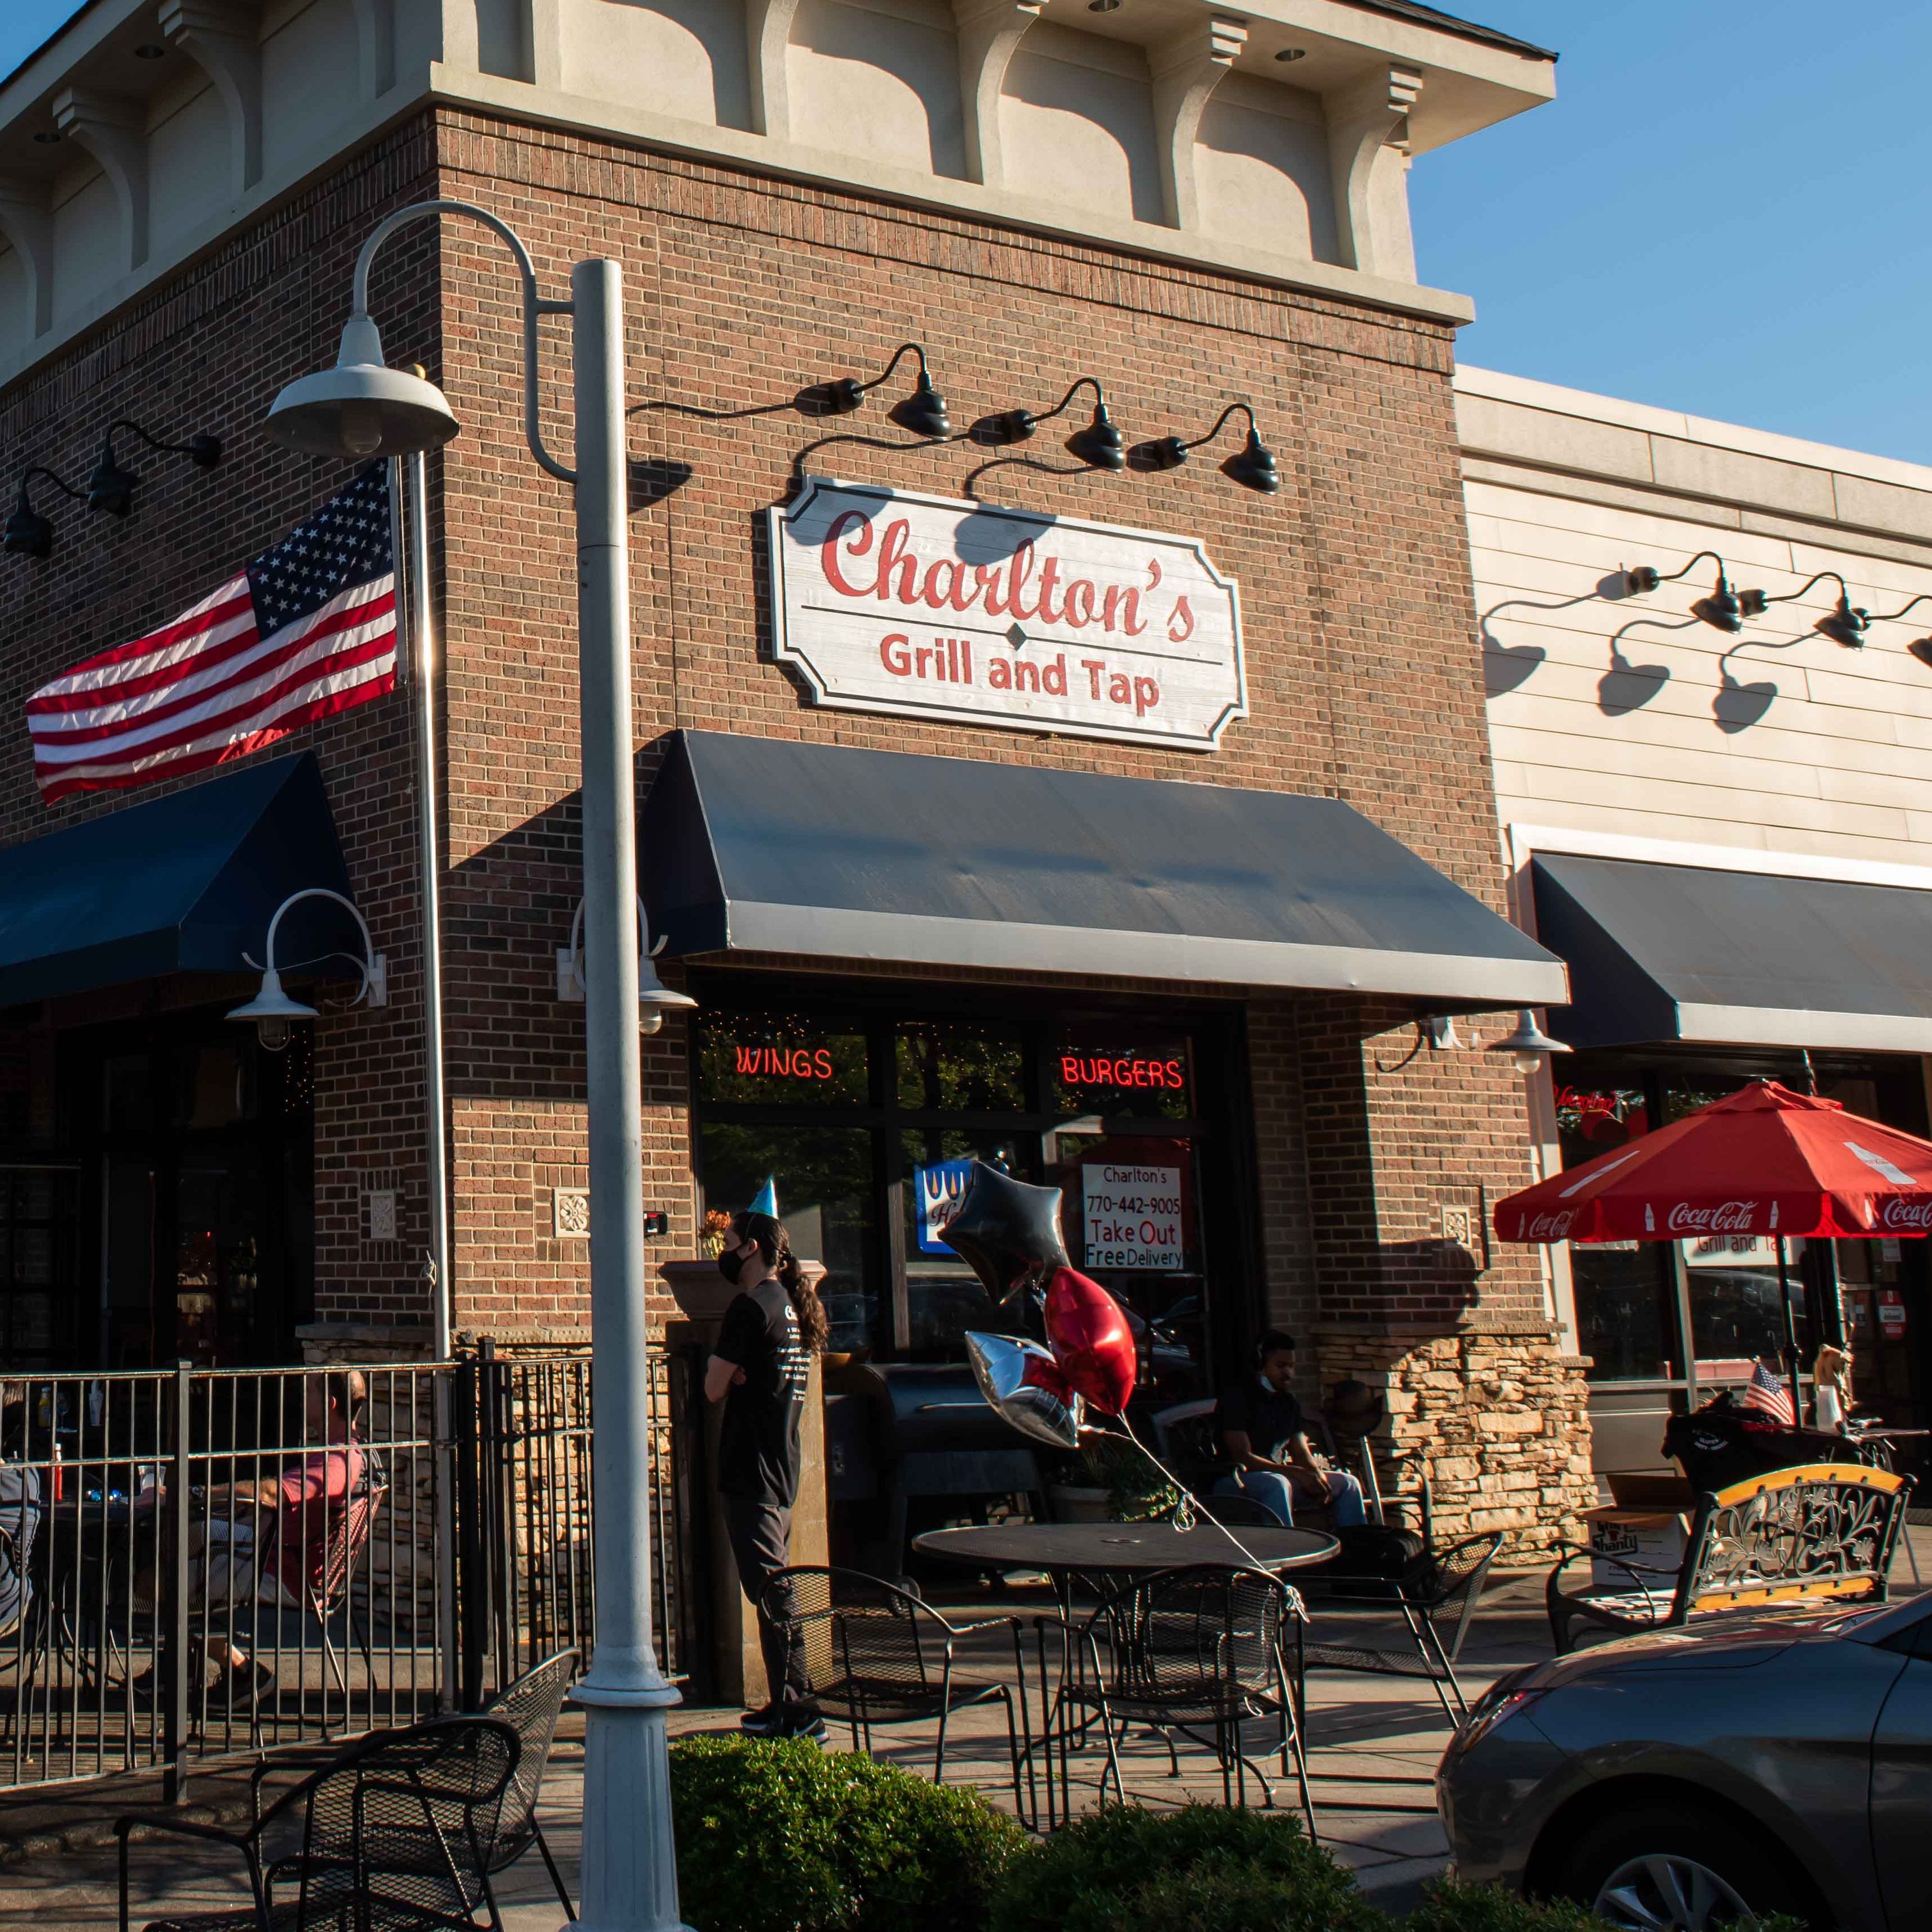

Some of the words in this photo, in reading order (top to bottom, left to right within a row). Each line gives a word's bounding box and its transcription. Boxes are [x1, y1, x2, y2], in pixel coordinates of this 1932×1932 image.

[821, 510, 1195, 643] Charlton's
[880, 633, 972, 685] Grill
[988, 653, 1067, 698] and
[1081, 659, 1160, 717] Tap
[736, 1046, 832, 1079] WINGS
[1060, 1056, 1183, 1089] BURGERS
[1103, 1167, 1167, 1184] Charlton's
[1086, 1195, 1180, 1215] 770-442-9005
[1668, 1201, 1758, 1231] Coca-Cola
[1883, 1198, 1932, 1228] Coca-C
[1090, 1219, 1134, 1242] Take
[1140, 1220, 1176, 1245] Out
[1731, 1235, 1757, 1252] and
[1086, 1244, 1125, 1266] Free
[1127, 1248, 1182, 1269] Delivery
